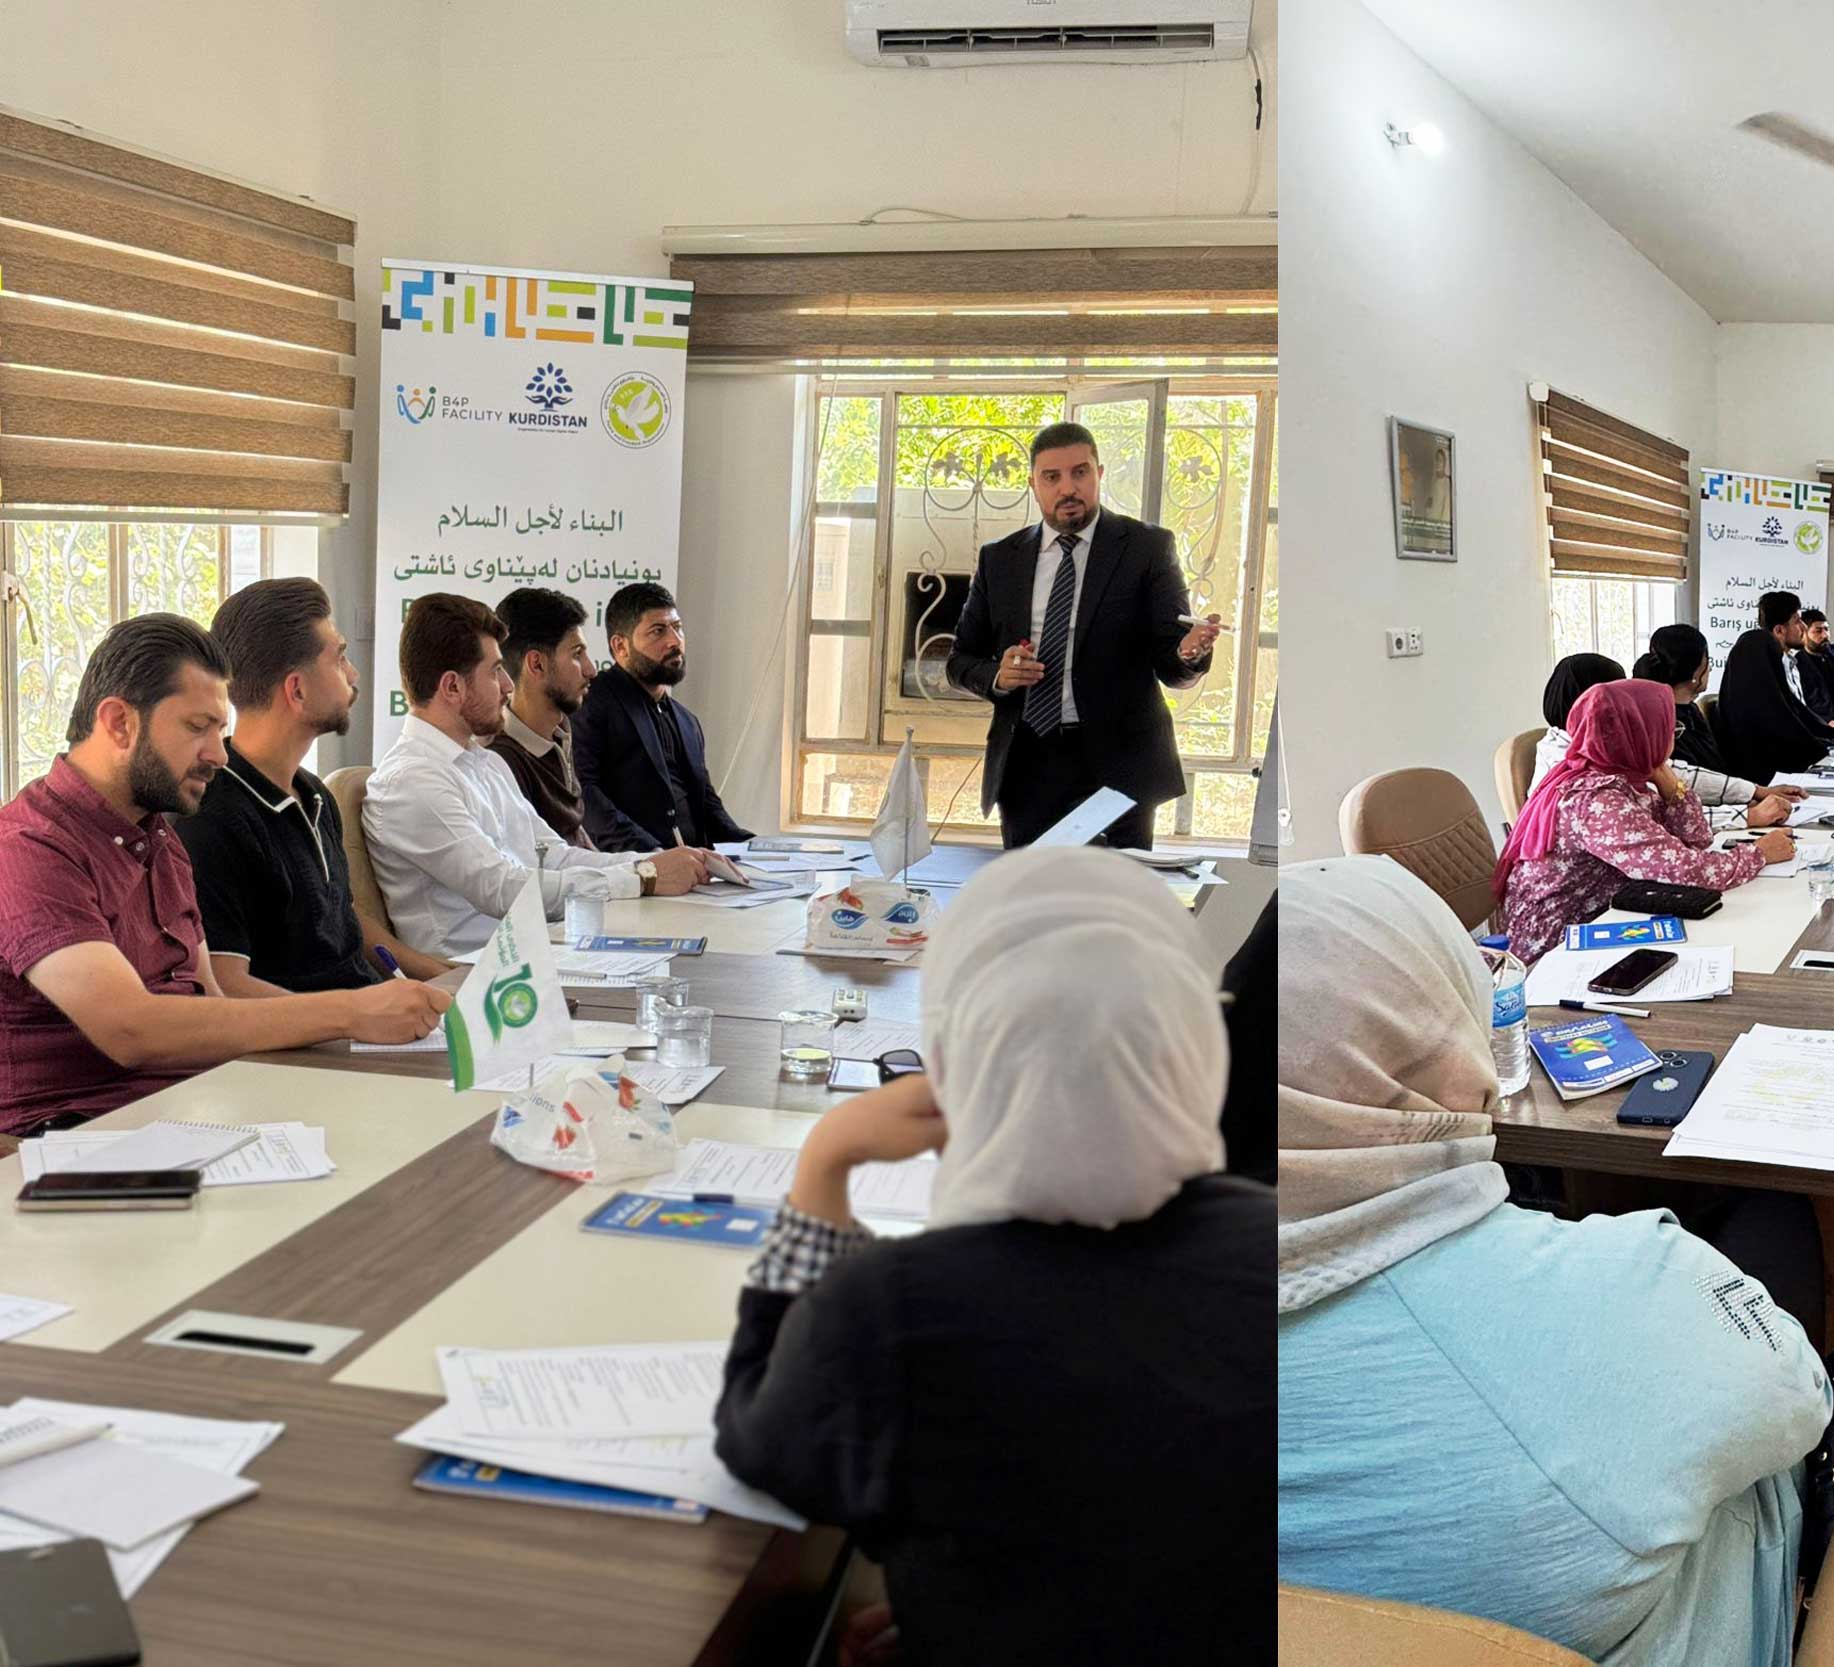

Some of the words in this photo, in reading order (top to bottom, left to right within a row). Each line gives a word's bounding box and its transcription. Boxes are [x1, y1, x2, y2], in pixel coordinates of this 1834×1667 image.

[442, 396, 469, 407] B4P
[442, 408, 503, 421] FACILITY
[508, 412, 588, 428] KURDISTAN
[438, 504, 508, 536] السلام
[515, 504, 564, 535] لأجل
[569, 509, 624, 537] البناء
[1710, 617, 1742, 632] Barış
